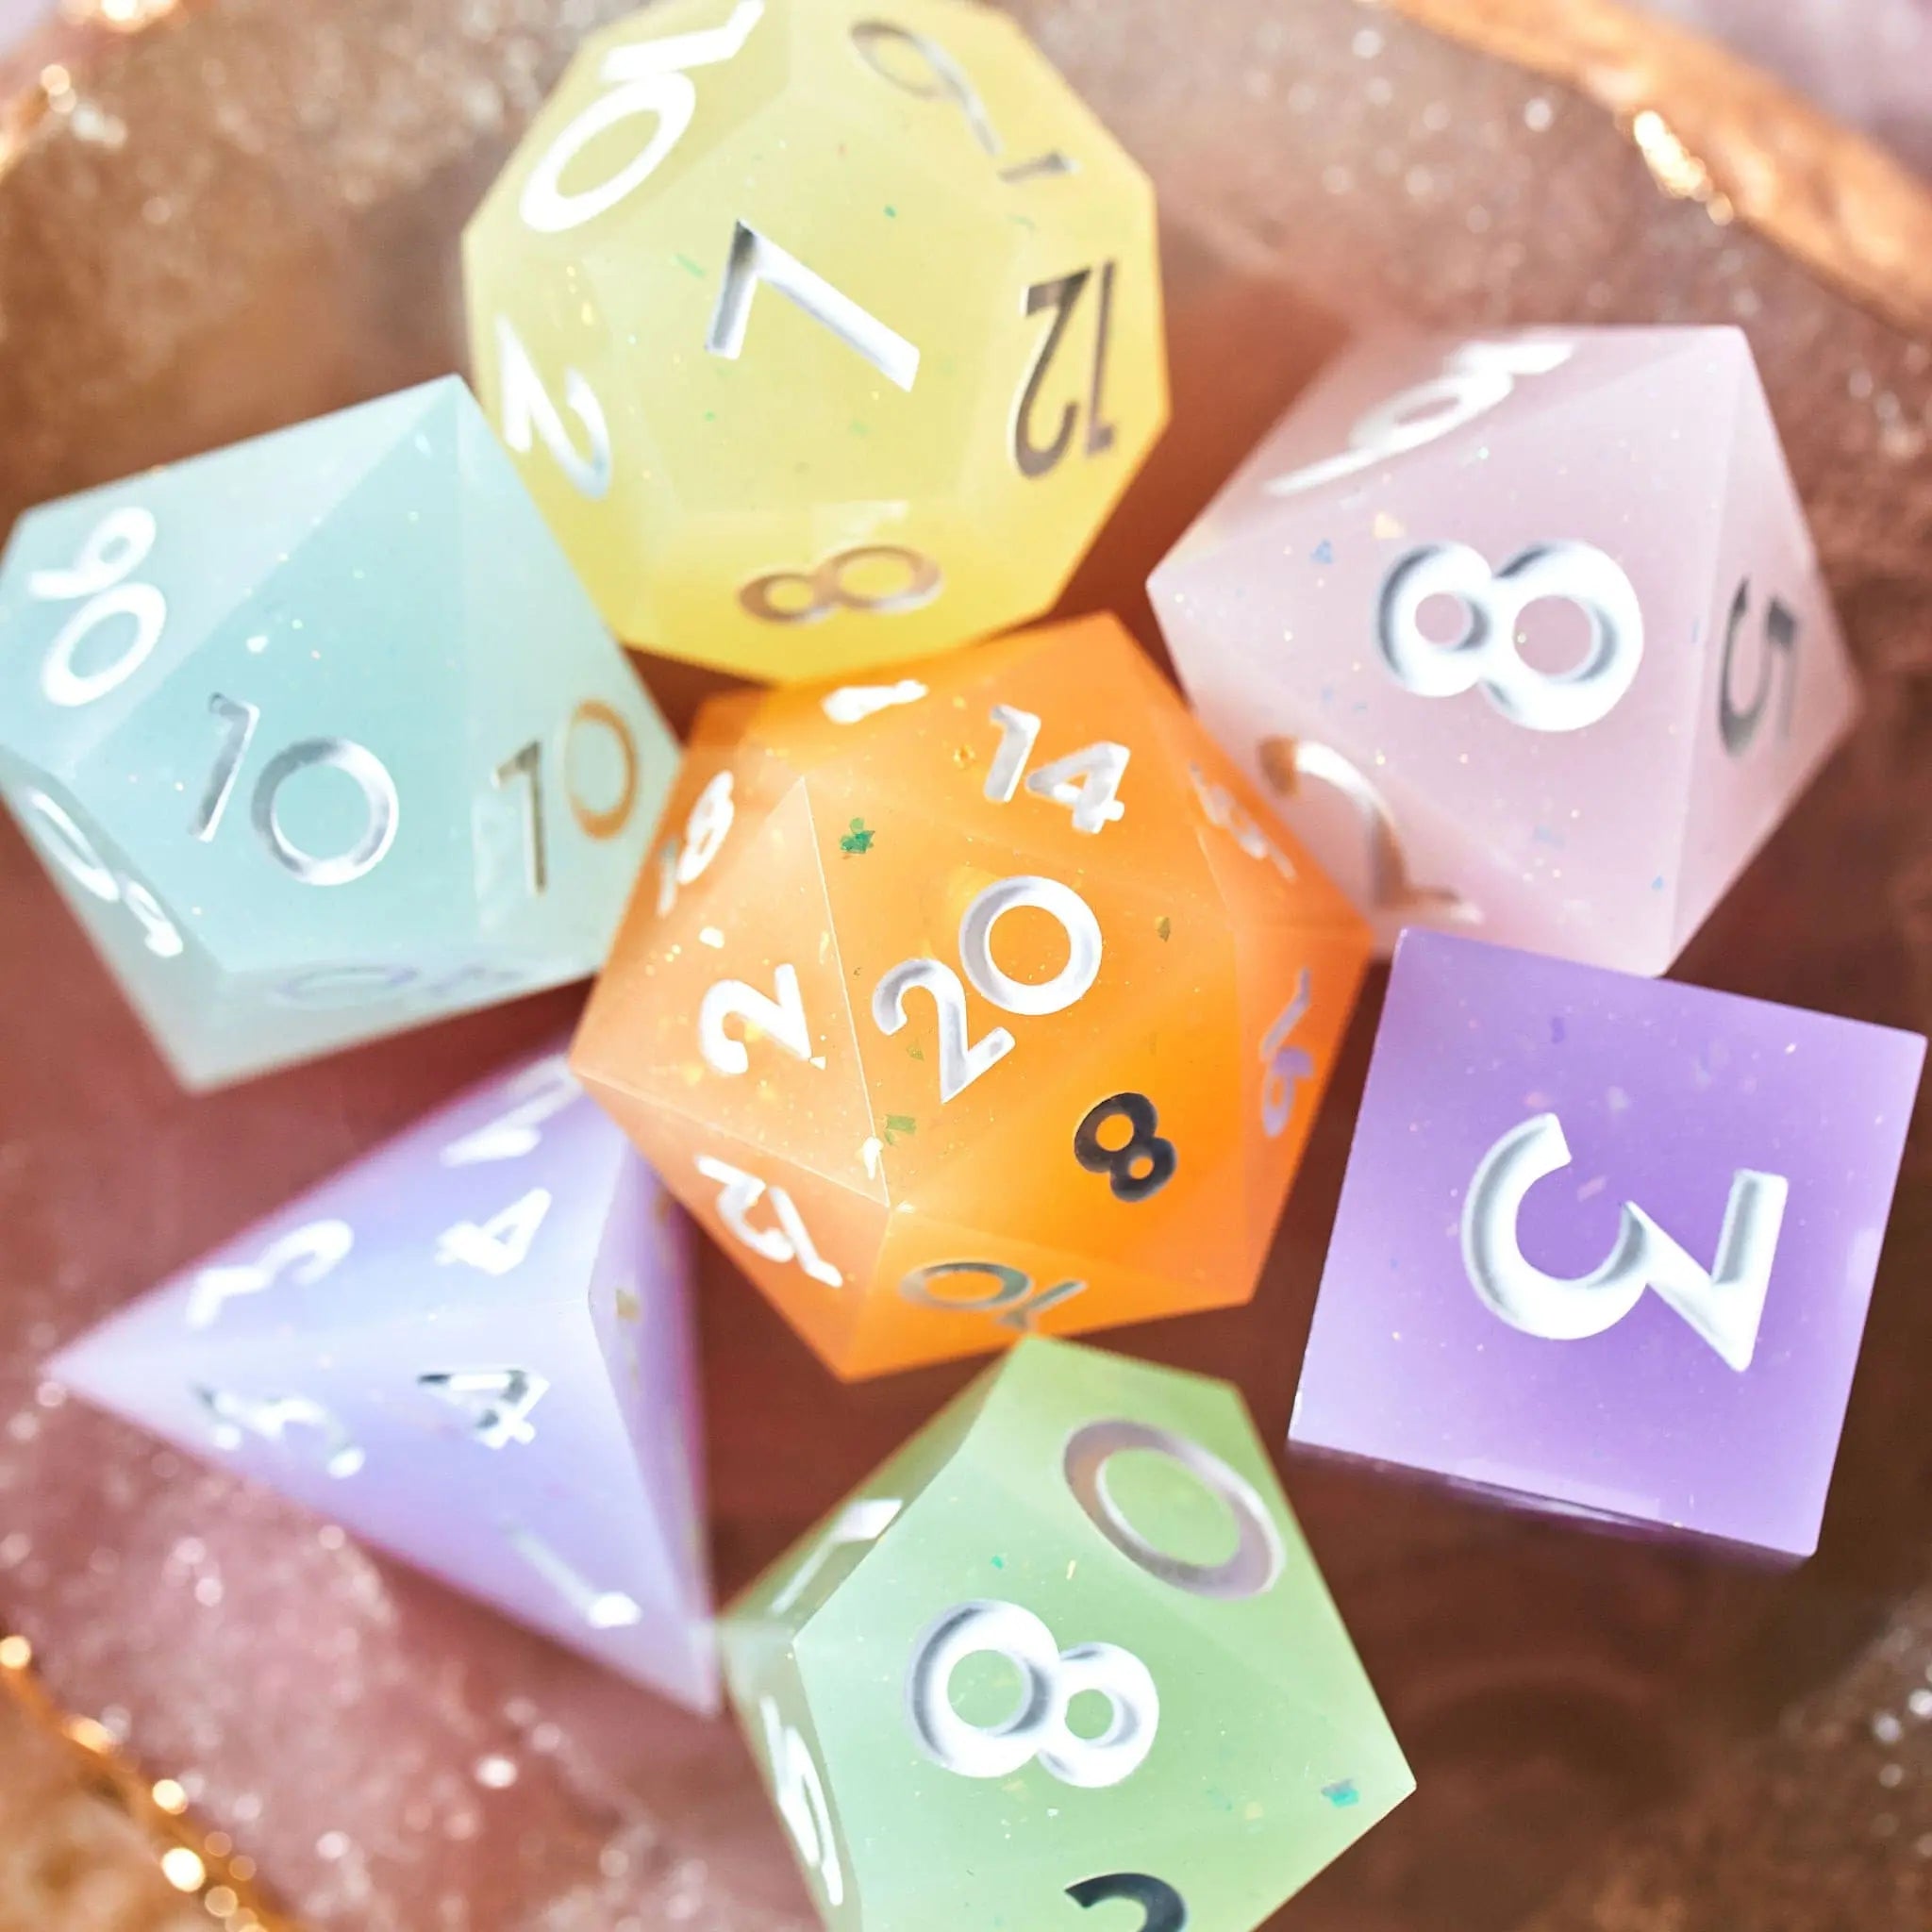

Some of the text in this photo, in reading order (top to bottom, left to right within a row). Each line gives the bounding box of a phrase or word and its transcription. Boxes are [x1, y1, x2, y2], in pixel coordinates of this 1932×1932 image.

[705, 217, 920, 391] 7
[1008, 258, 1117, 478] 12
[494, 313, 611, 501] 2
[738, 544, 942, 626] 8
[1374, 539, 1643, 732] 8
[1719, 575, 1802, 760] 5
[189, 691, 399, 886] 10
[982, 703, 1129, 834] 14
[700, 963, 811, 1074] 2
[873, 874, 1103, 1104] 20
[435, 1188, 551, 1274] 4
[1074, 1091, 1176, 1203] 8
[1461, 1112, 1789, 1373] 3
[416, 1369, 551, 1450] 4
[1061, 1420, 1286, 1601] 0
[905, 1599, 1159, 1788] 8
